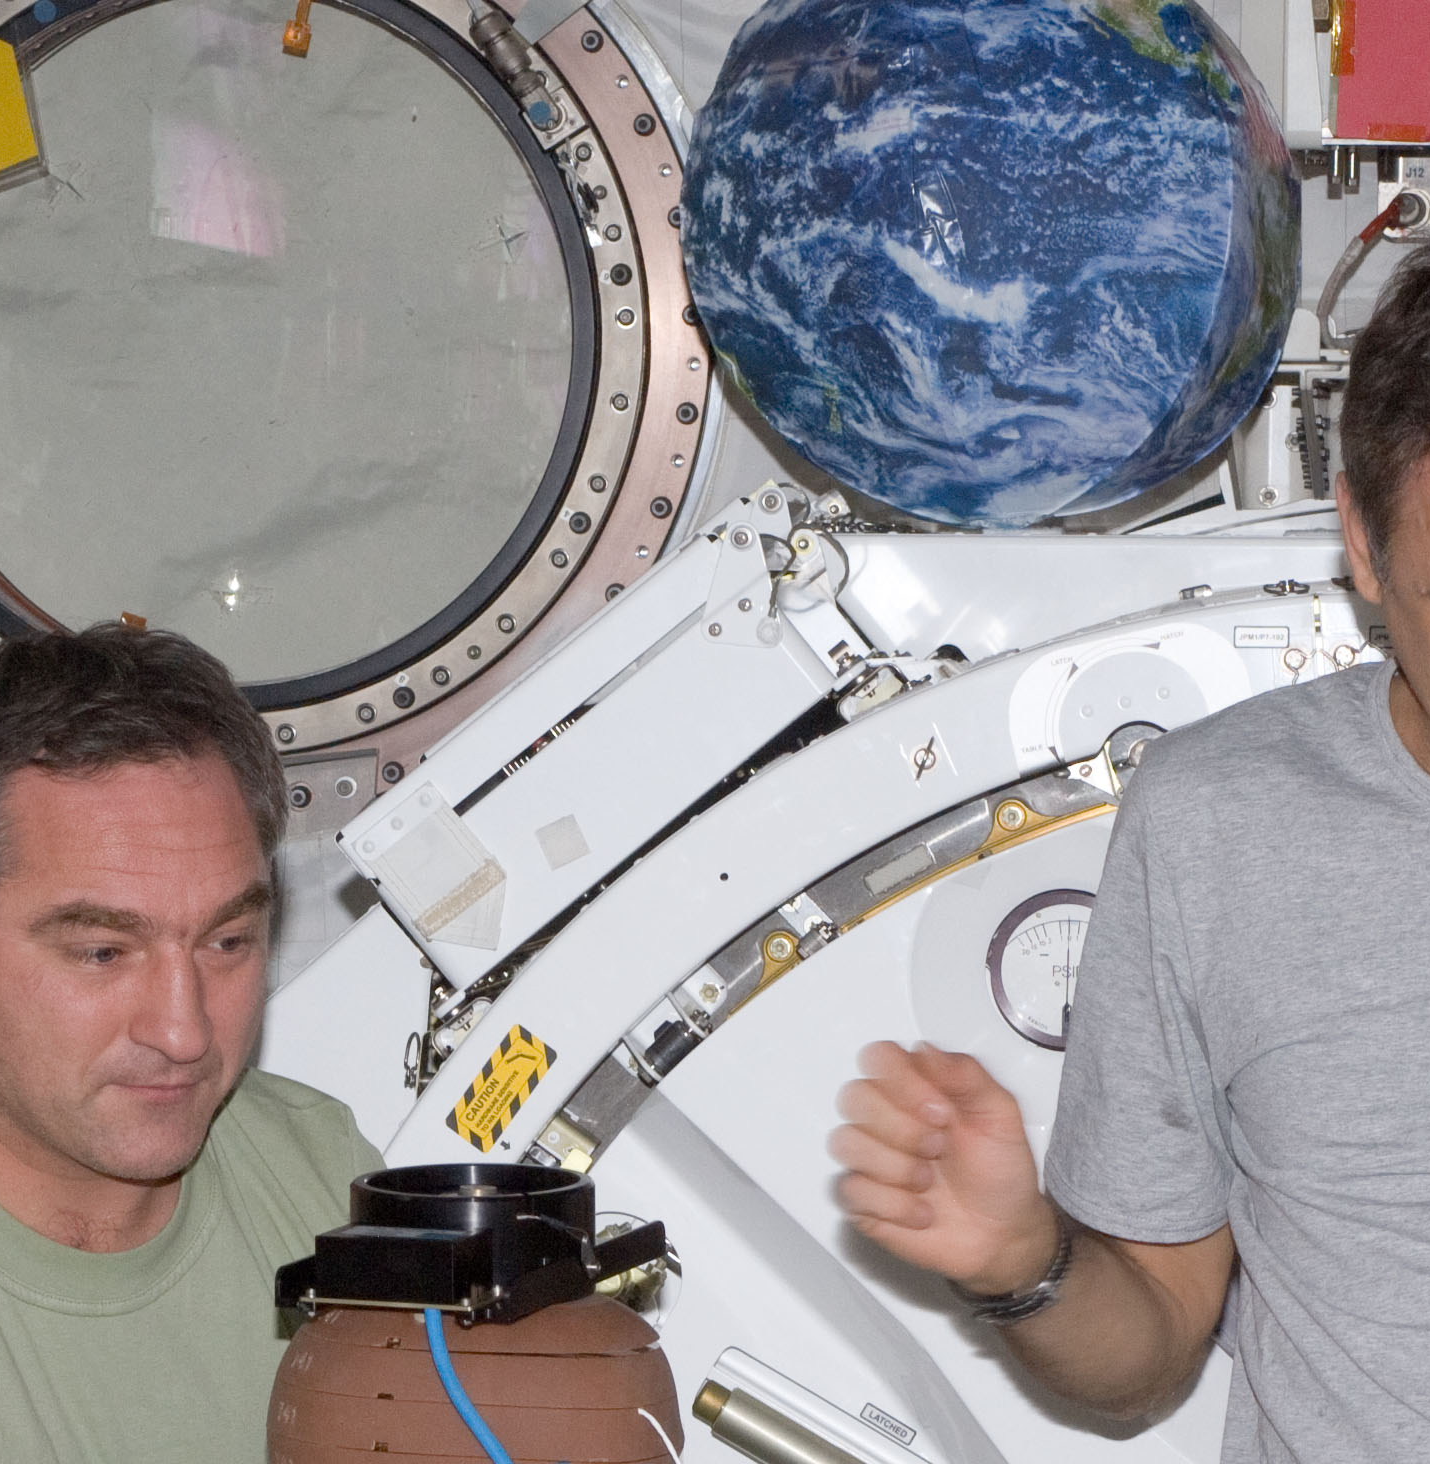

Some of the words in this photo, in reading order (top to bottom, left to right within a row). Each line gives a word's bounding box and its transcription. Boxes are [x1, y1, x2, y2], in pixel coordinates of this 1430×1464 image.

[1405, 167, 1425, 179] J12
[1050, 656, 1073, 667] LATCH
[1052, 965, 1080, 979] PSI
[466, 1078, 499, 1121] CAUTION
[868, 1411, 909, 1437] LATCHED
